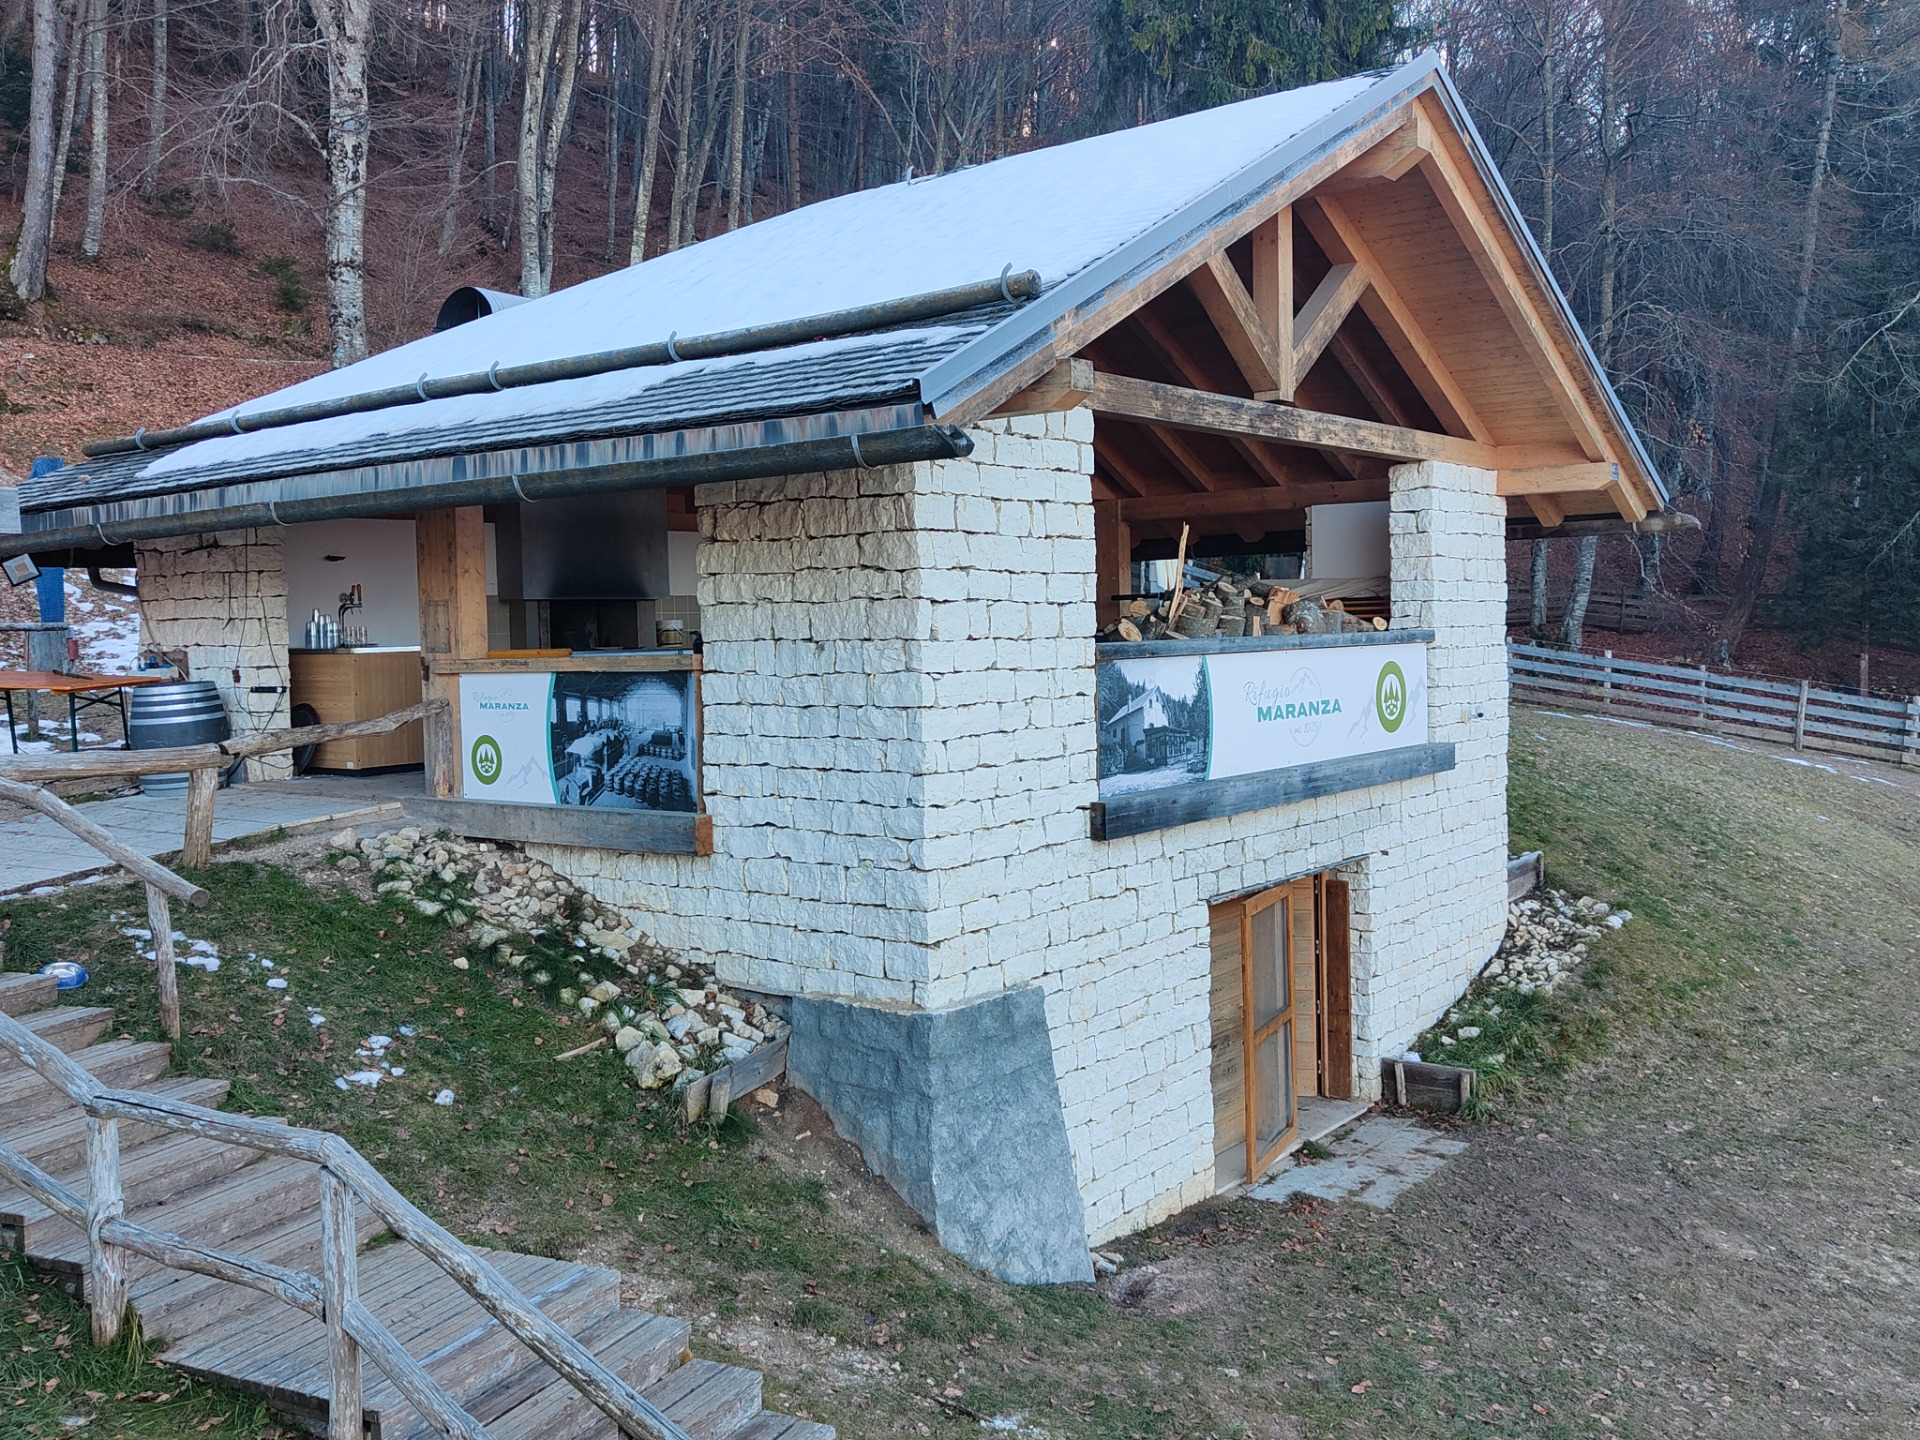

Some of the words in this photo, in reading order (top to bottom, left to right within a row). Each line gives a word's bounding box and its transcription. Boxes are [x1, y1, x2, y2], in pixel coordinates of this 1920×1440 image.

[480, 702, 529, 710] MARANZA
[1243, 680, 1291, 708] Rifugio
[1257, 698, 1342, 722] MARANZA
